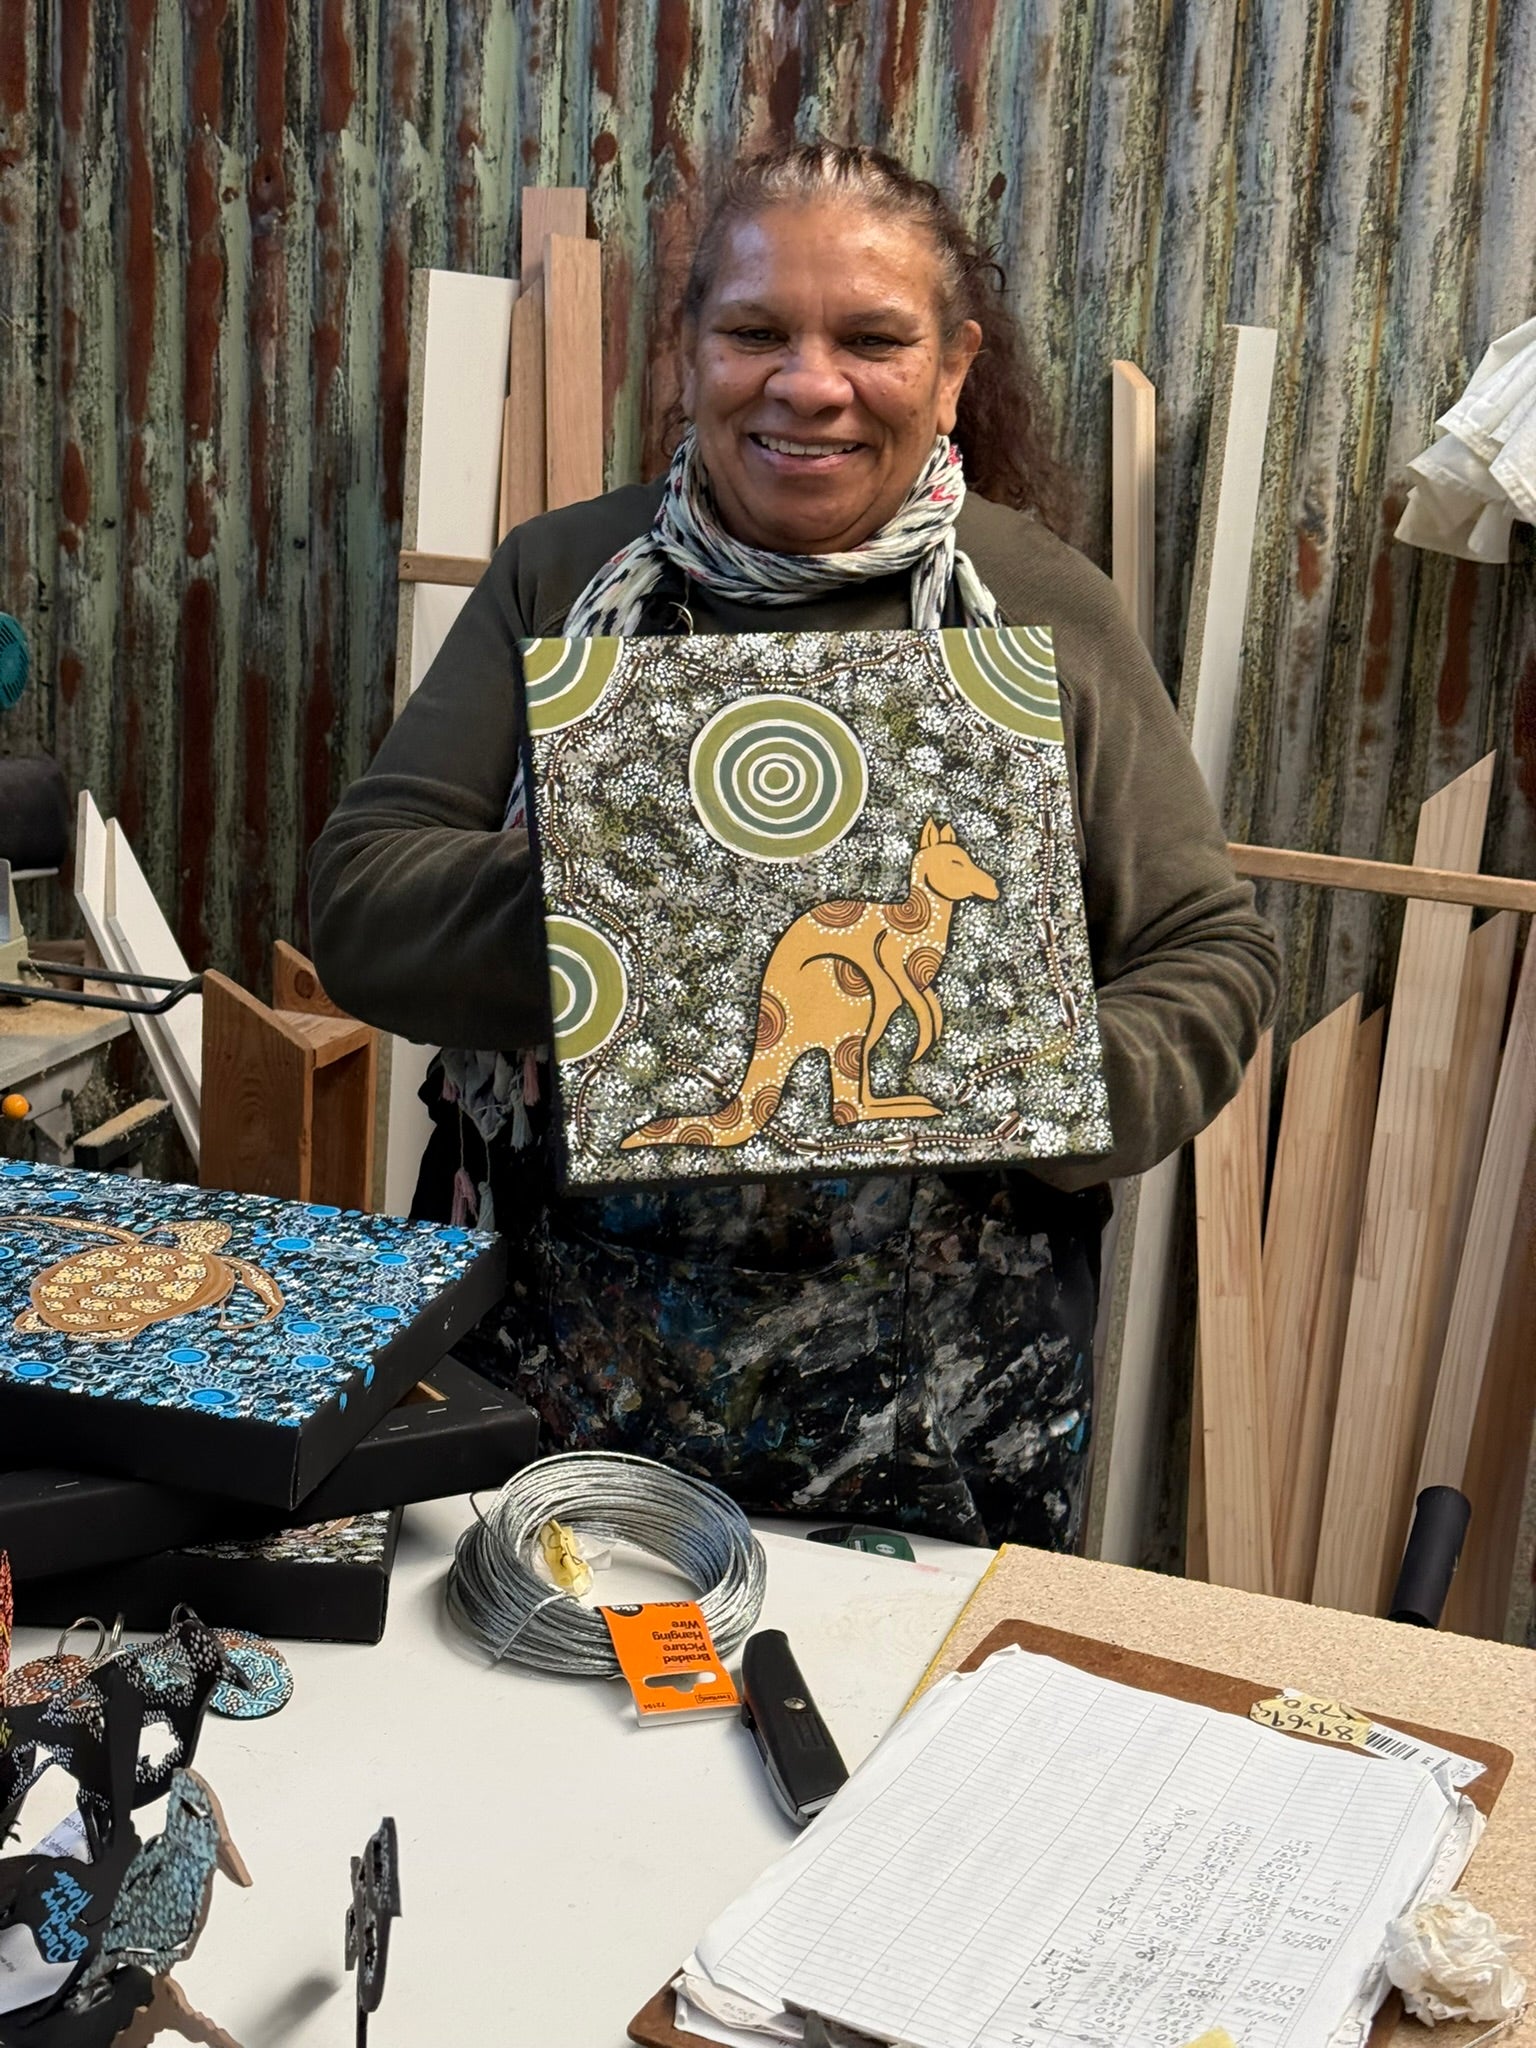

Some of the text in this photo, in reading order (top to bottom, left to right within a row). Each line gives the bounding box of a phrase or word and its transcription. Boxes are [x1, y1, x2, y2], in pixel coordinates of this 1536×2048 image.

[671, 1620, 702, 1629] Wire
[651, 1631, 704, 1642] Hanging
[662, 1642, 708, 1652] Picture
[662, 1653, 712, 1664] Braided
